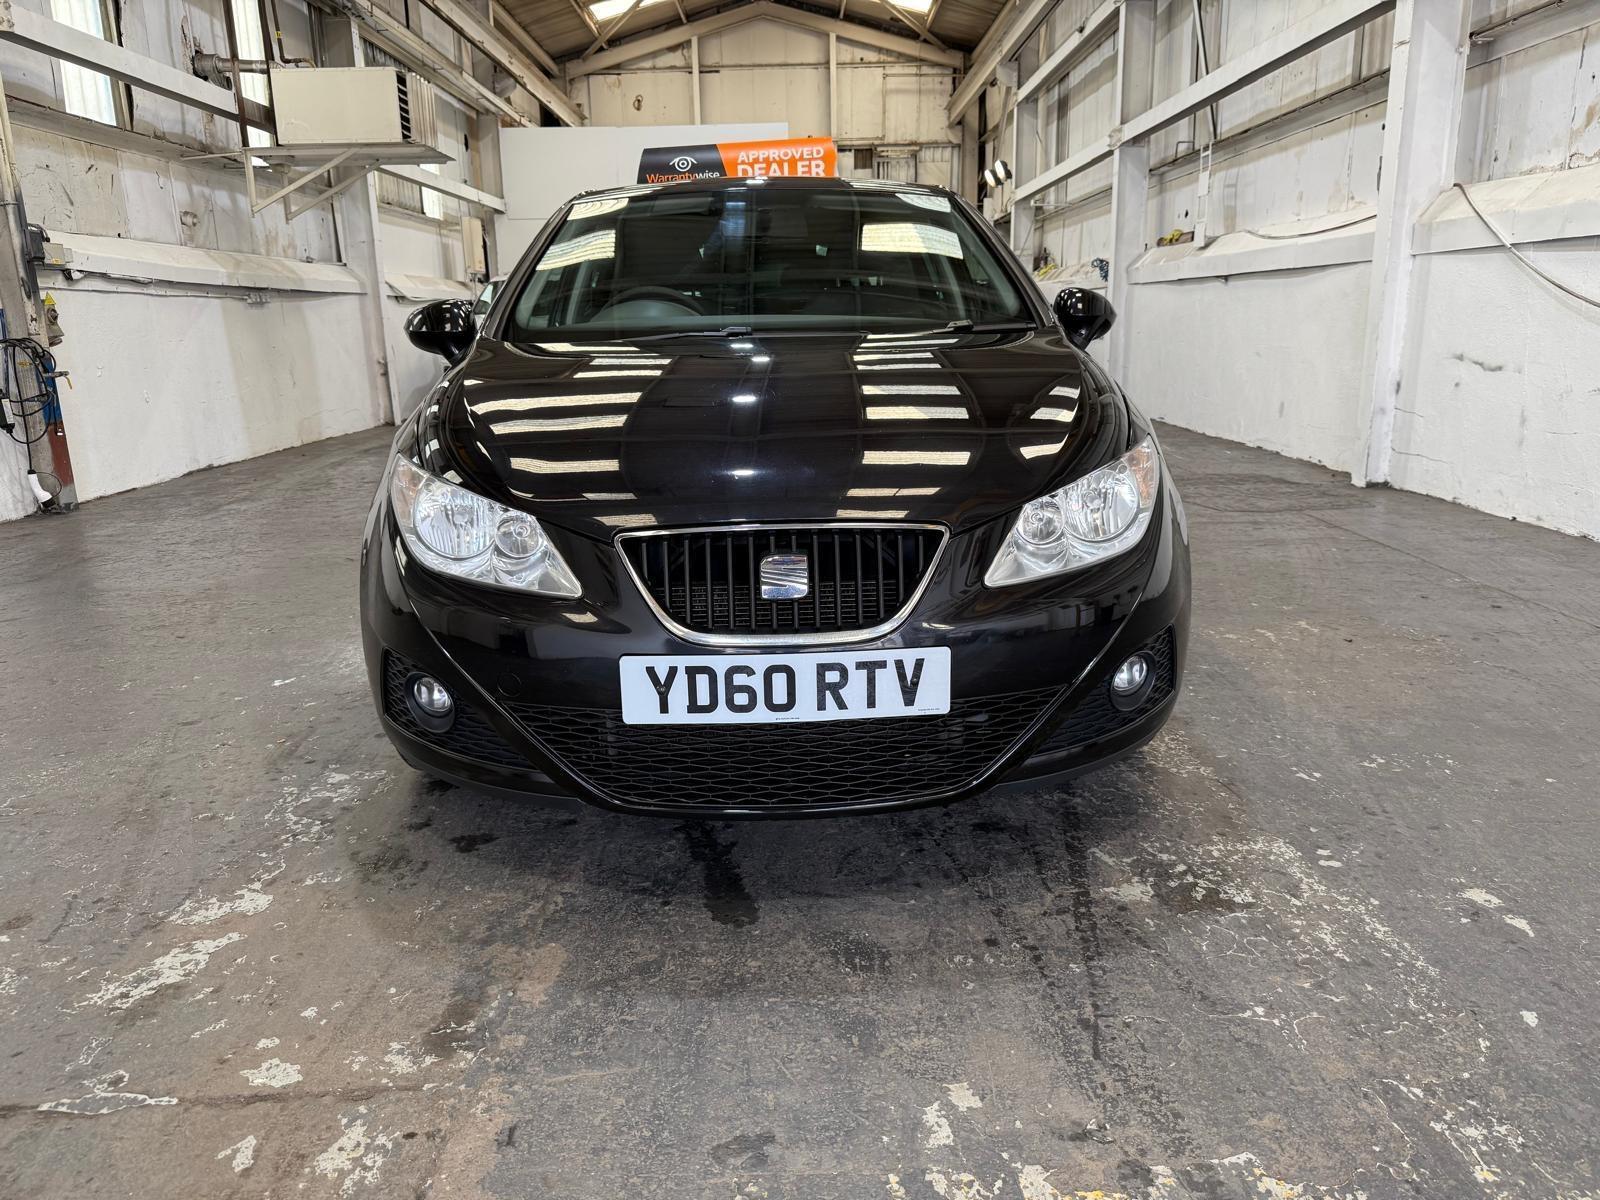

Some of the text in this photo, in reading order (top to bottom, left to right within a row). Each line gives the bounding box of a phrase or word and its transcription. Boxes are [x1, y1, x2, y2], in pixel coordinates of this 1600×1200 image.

[737, 146, 824, 163] APPROVED
[646, 170, 720, 184] Warrantywise
[737, 160, 826, 177] DEALER
[645, 658, 925, 715] YD60 RTV
